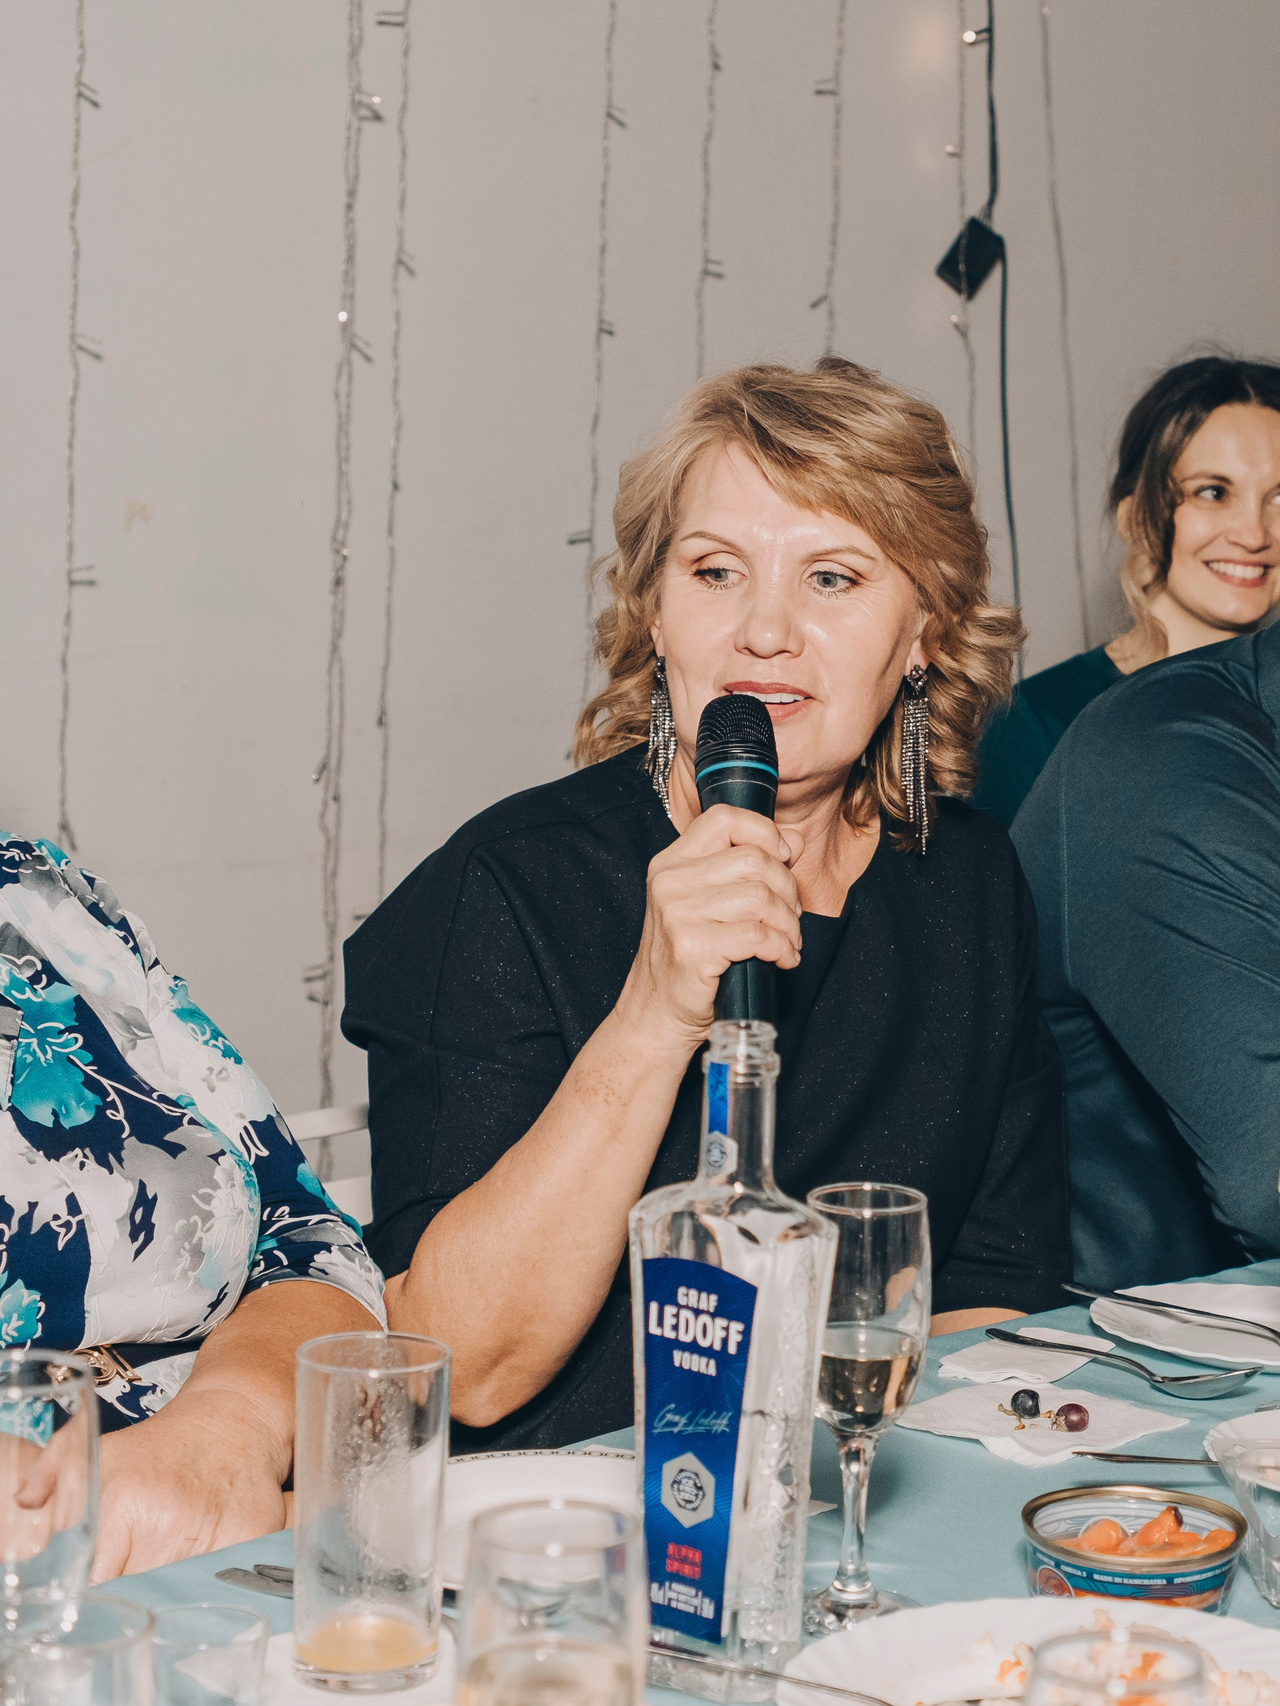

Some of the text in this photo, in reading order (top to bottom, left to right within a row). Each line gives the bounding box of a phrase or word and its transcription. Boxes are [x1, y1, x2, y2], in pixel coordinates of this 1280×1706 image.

[677, 1286, 719, 1313] GRAF
[648, 1301, 745, 1355] LEDOFF
[672, 1349, 717, 1377] VODKA
